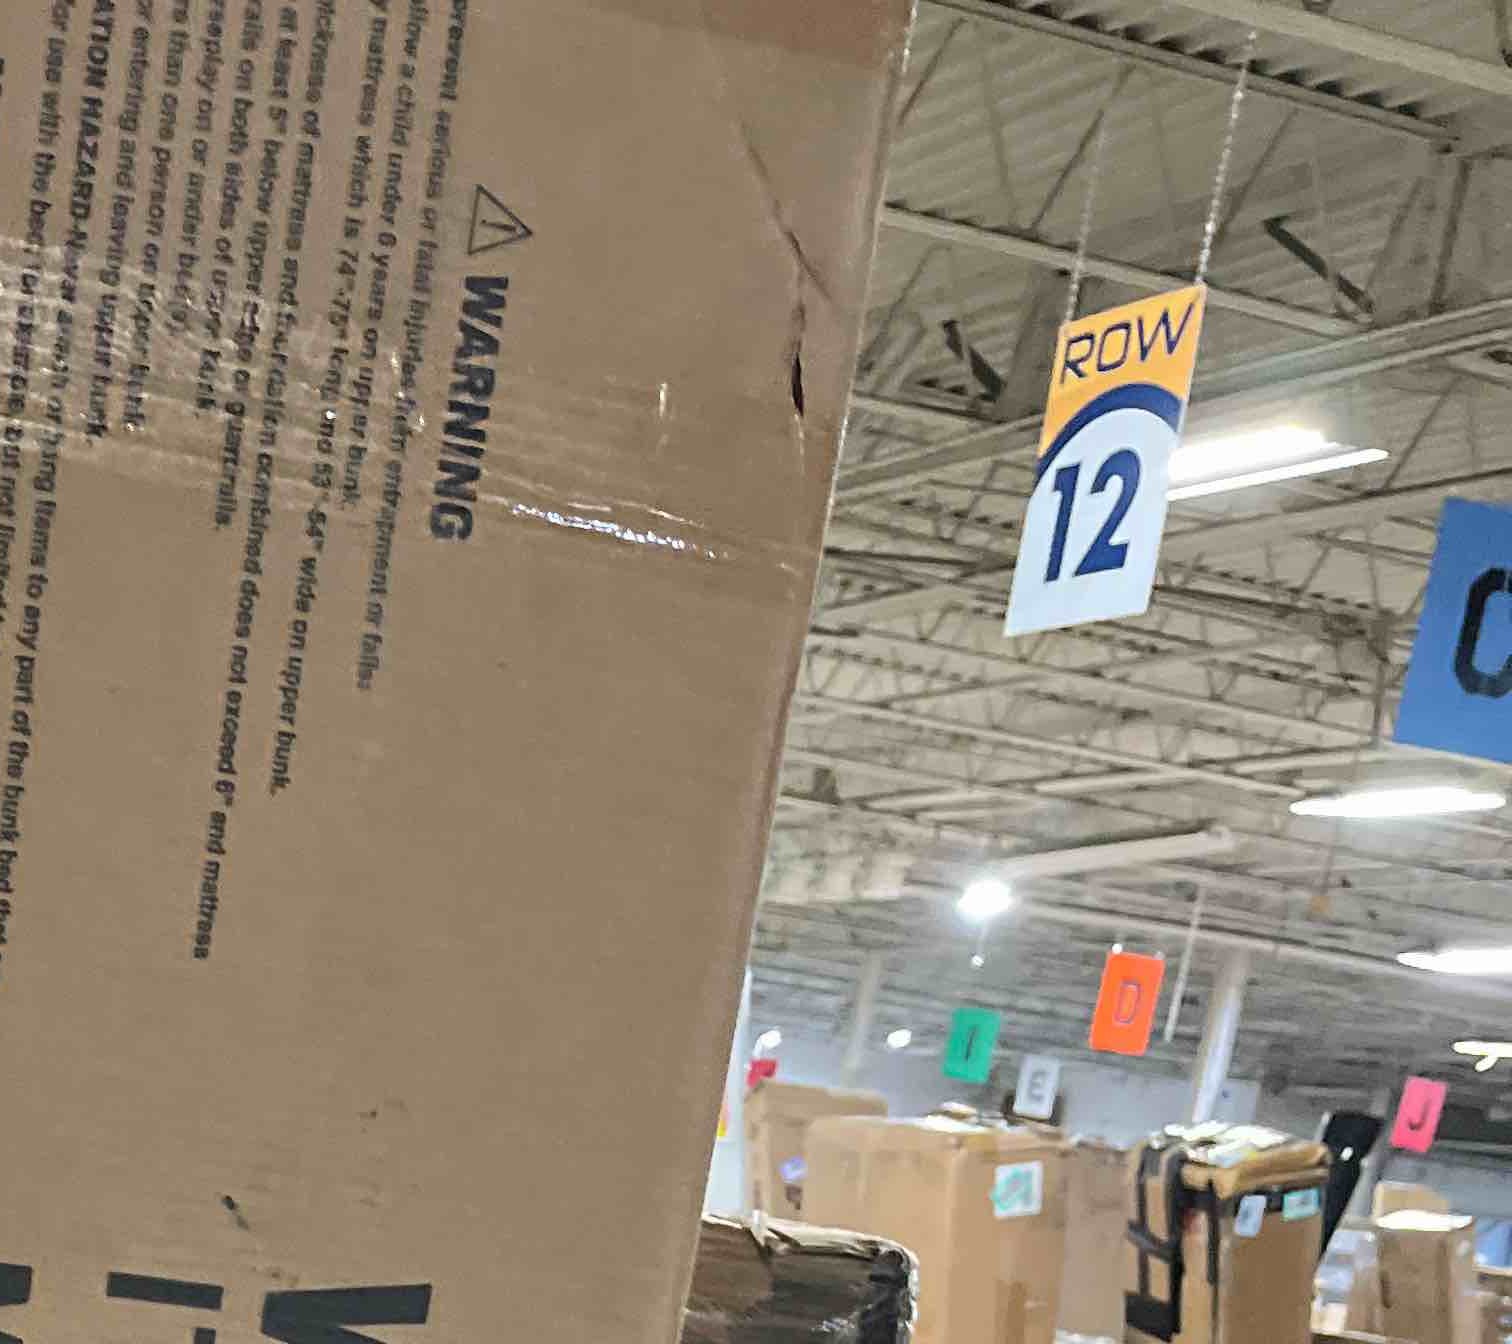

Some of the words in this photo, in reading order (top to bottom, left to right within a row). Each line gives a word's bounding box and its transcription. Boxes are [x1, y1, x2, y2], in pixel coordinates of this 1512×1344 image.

[432, 278, 507, 540] WARNING
[1060, 301, 1197, 386] ROW
[1043, 447, 1142, 584] 12
